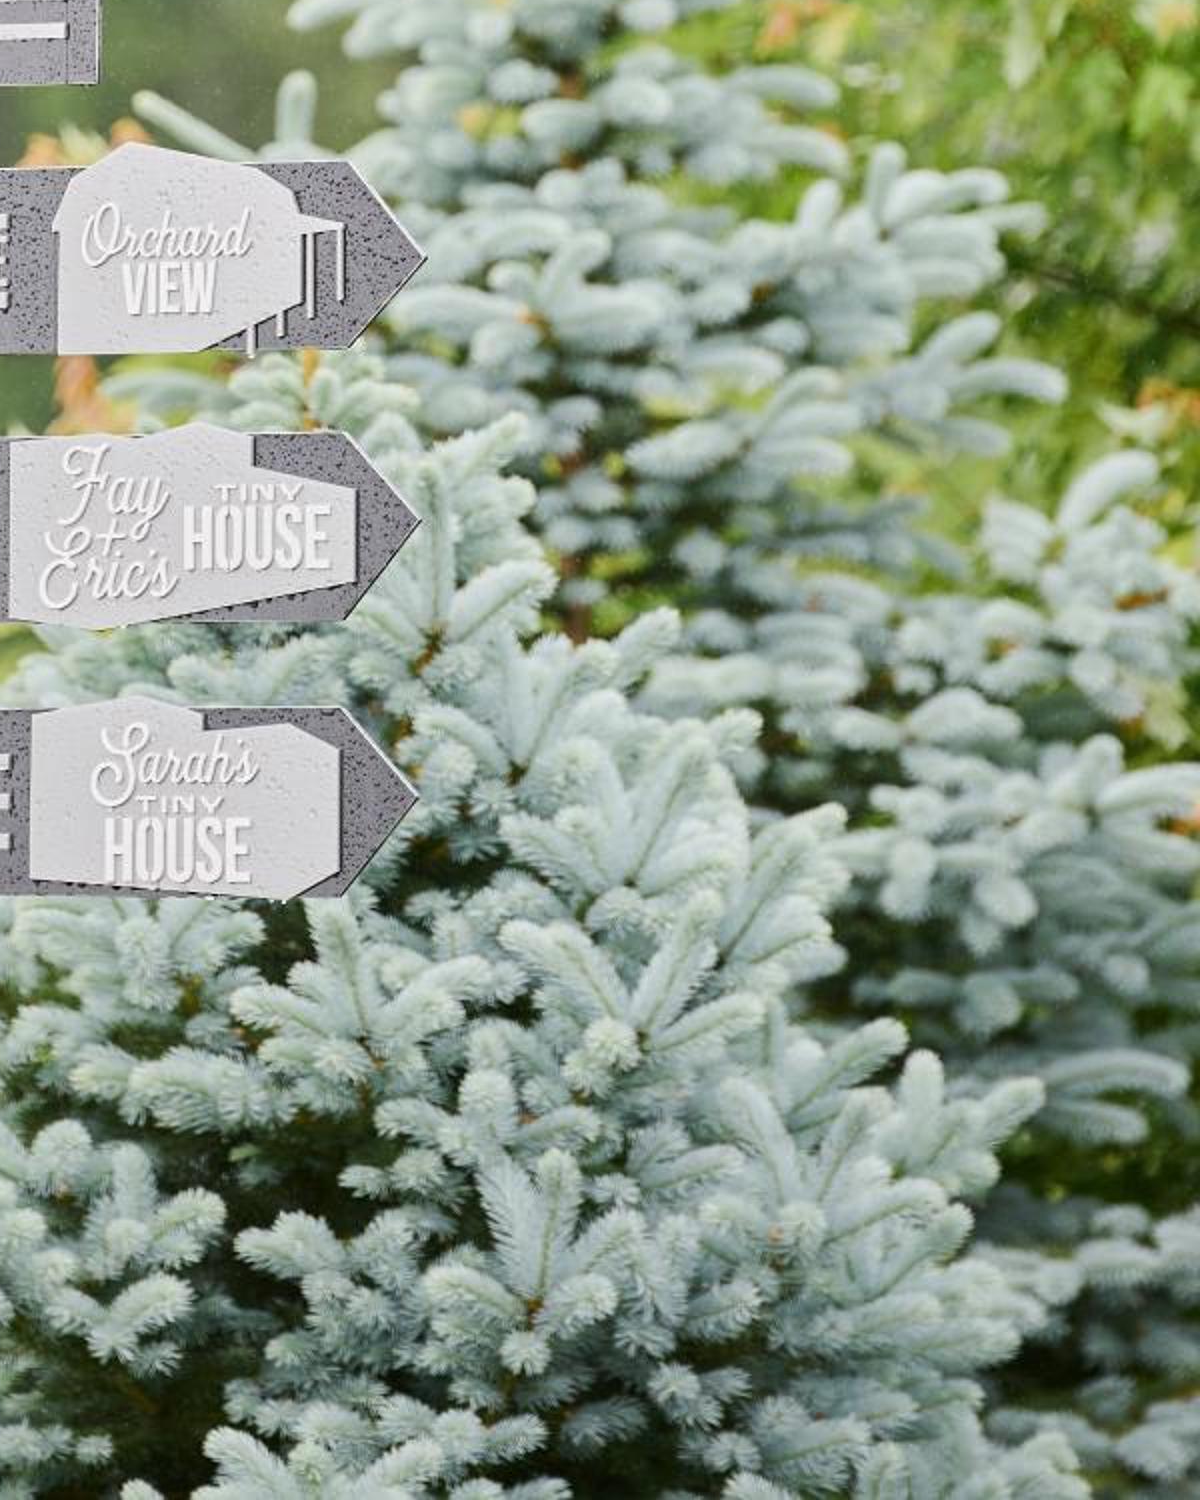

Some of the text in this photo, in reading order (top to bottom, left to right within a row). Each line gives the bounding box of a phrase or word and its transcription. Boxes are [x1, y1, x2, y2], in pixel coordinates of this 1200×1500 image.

[81, 202, 254, 268] Orchard
[121, 258, 219, 316] VIEW
[58, 444, 170, 541] Fay
[213, 482, 304, 501] TINY
[183, 503, 332, 573] HOUSE
[135, 794, 226, 813] TINY
[104, 816, 252, 884] HOUSE
